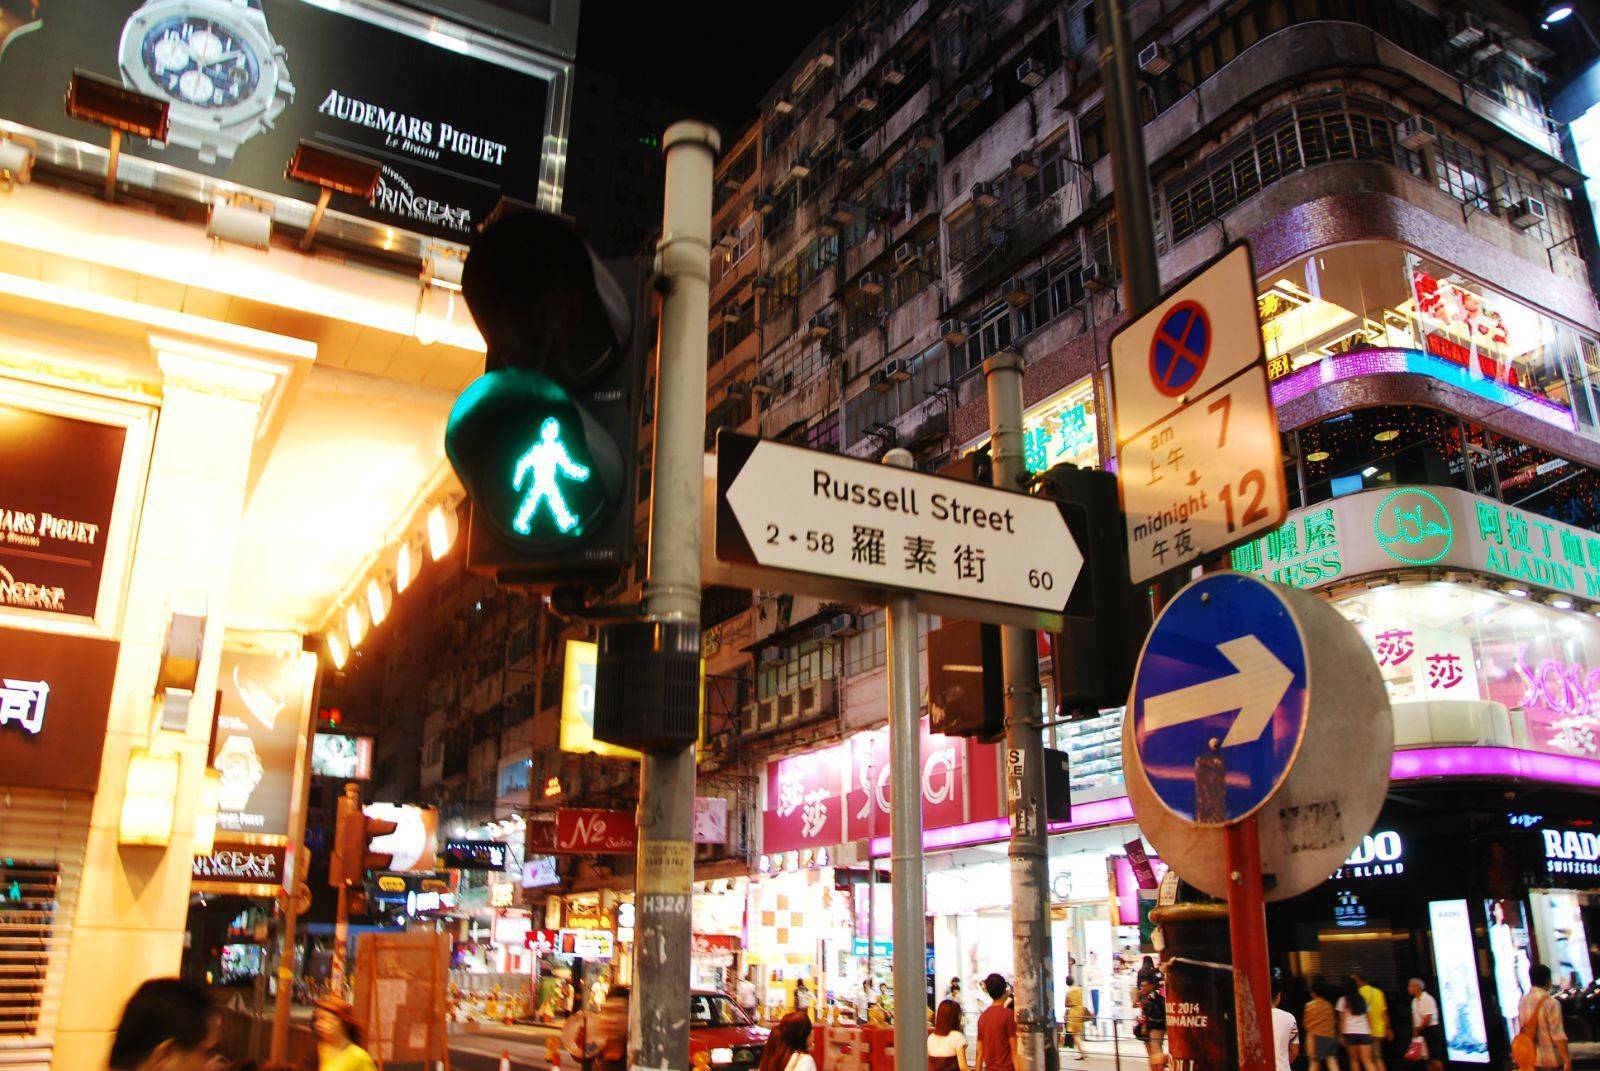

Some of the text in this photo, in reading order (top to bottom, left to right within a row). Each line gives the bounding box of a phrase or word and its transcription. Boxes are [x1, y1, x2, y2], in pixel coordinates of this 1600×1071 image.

[318, 89, 507, 166] AUDEMARS PIGUET
[1151, 394, 1233, 450] am 7
[1147, 447, 1185, 486] 上午
[813, 470, 1015, 534] Russell Street
[1133, 468, 1269, 542] midnight 12
[39, 512, 99, 544] PIGUET
[1152, 528, 1193, 565] 午夜
[852, 524, 987, 583] 羅素街
[1028, 569, 1054, 591] 60
[1257, 551, 1342, 590] ESS
[1487, 545, 1575, 590] ALADIN
[1375, 628, 1464, 689] 莎莎
[1344, 831, 1402, 864] DO
[1541, 829, 1600, 860] RAD
[1547, 860, 1600, 875] SWITZERL
[1178, 1002, 1200, 1014] 2014
